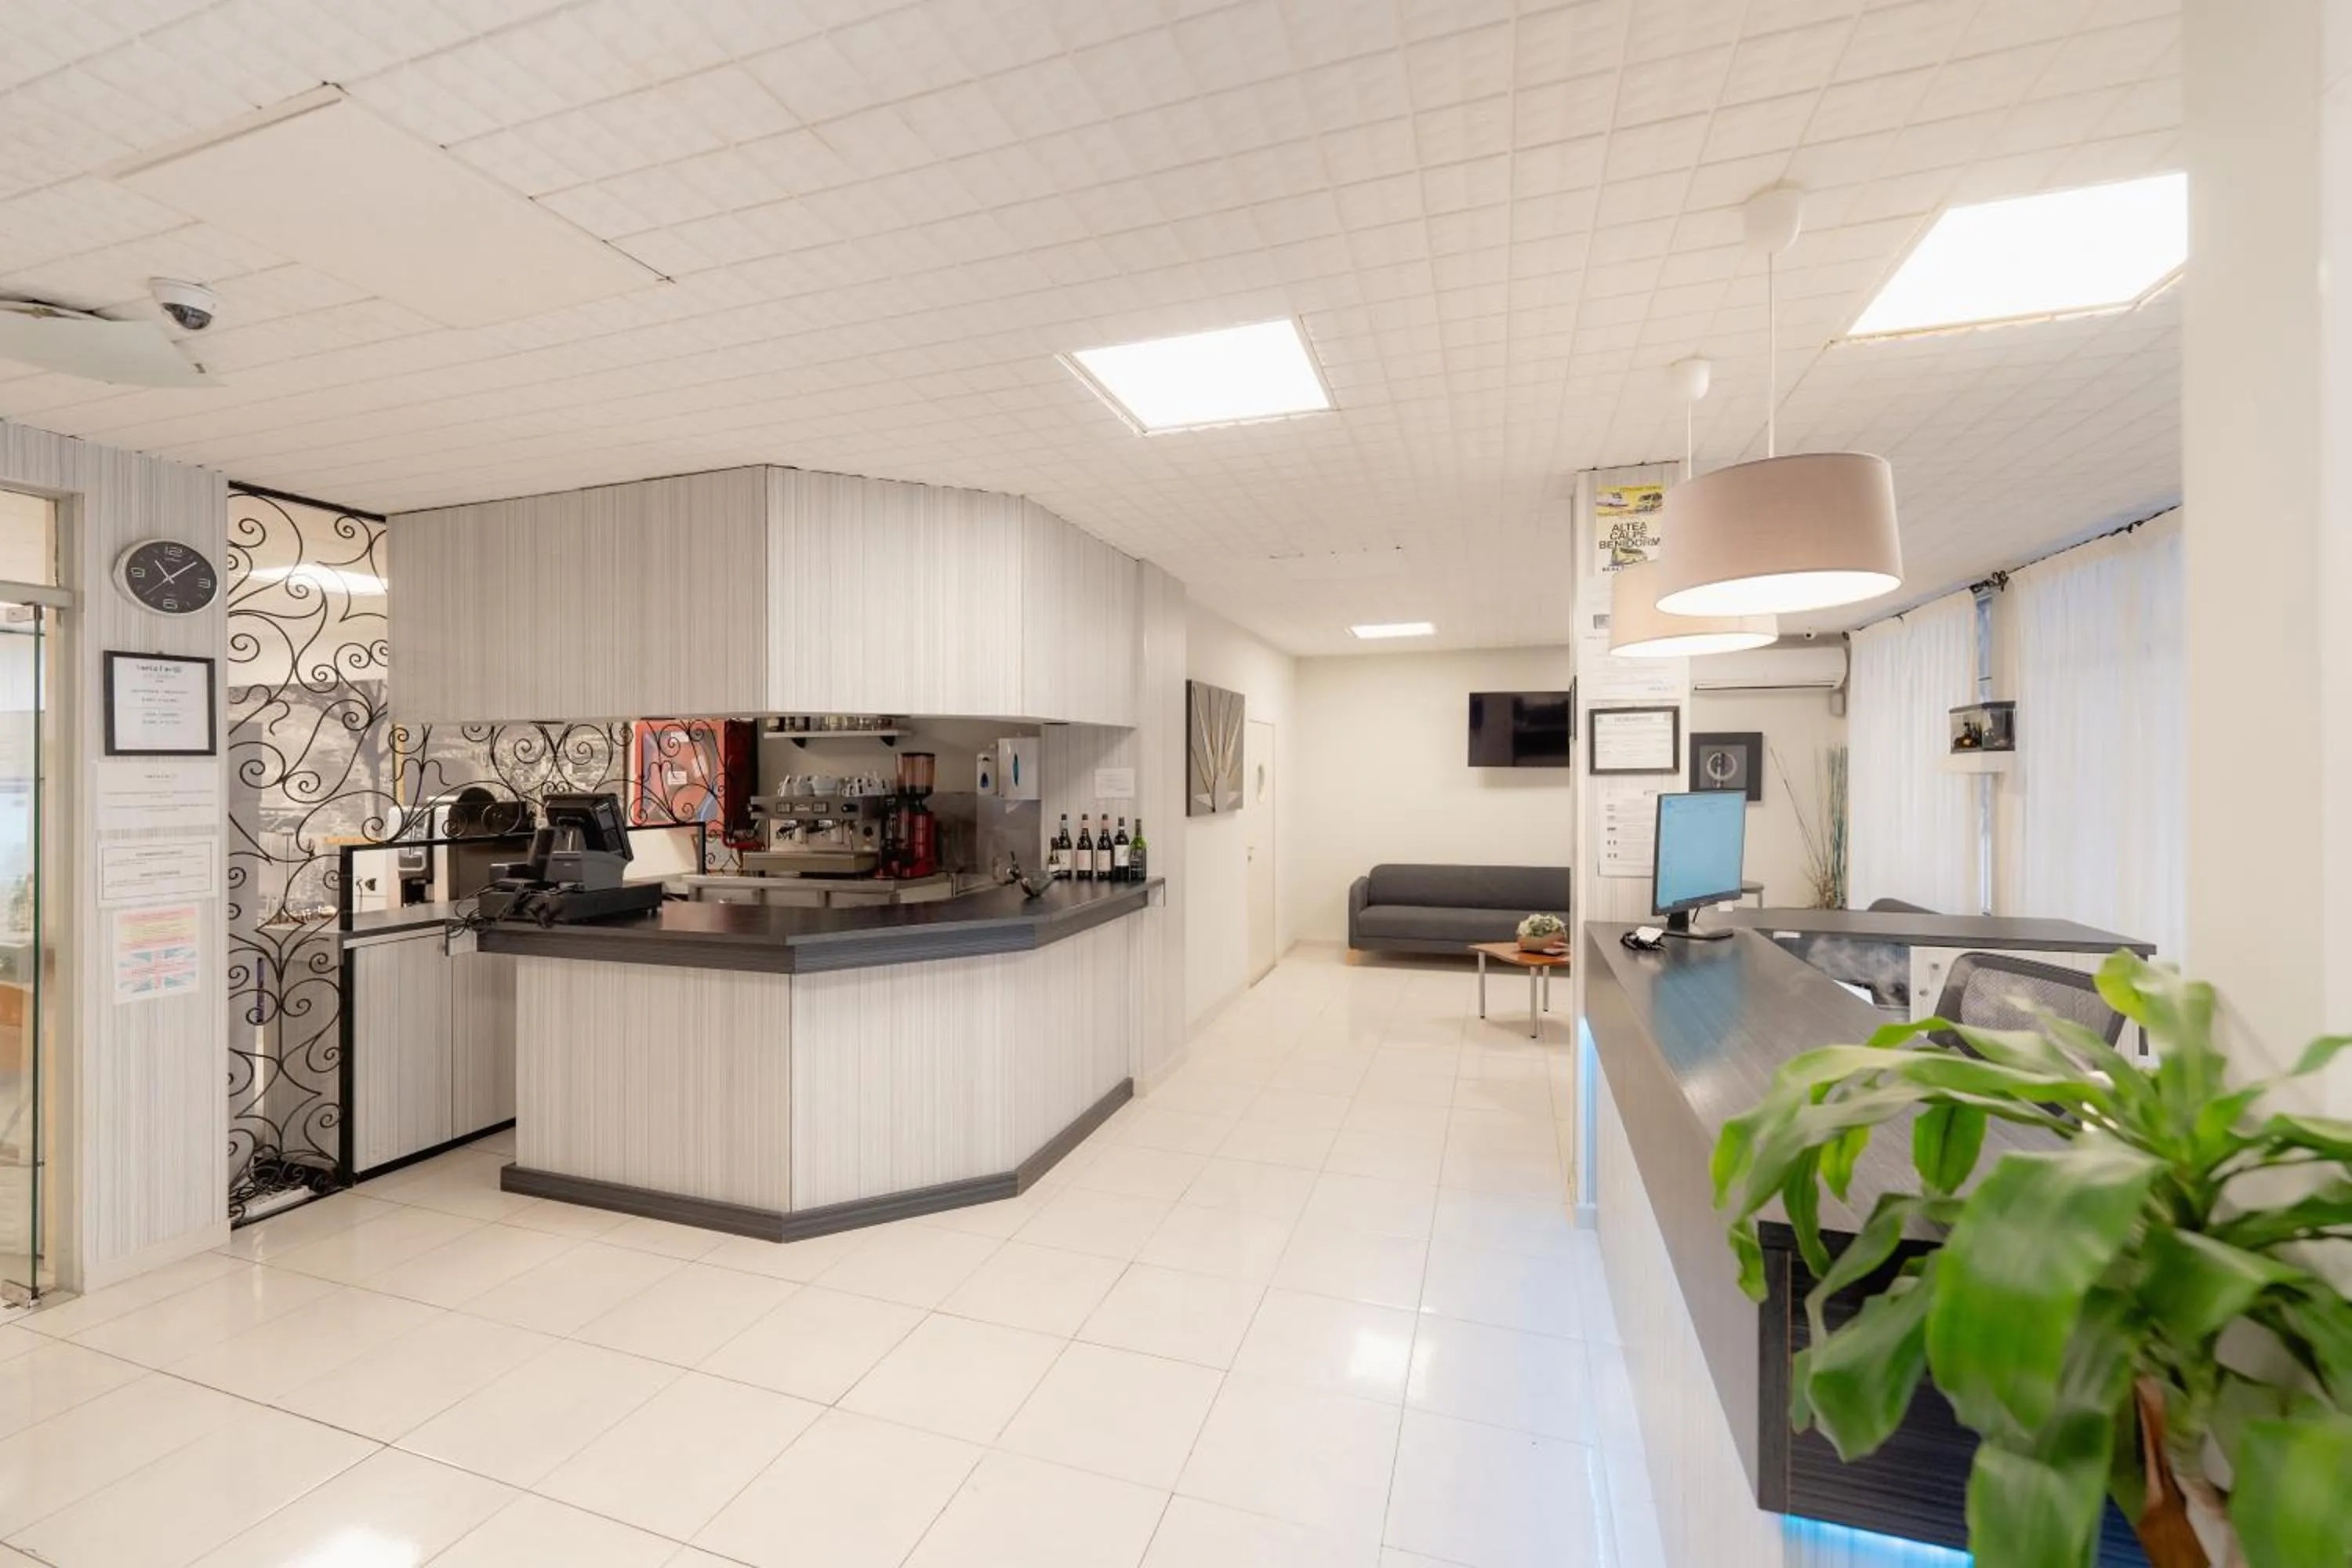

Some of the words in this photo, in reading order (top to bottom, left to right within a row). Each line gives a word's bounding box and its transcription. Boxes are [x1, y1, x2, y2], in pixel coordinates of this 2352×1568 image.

[1611, 521, 1647, 532] ALTEA
[1610, 530, 1647, 540] CALPE
[1599, 537, 1661, 550] BENIDORM
[165, 546, 183, 557] 12
[131, 567, 146, 578] 9
[198, 578, 211, 589] 3
[162, 598, 178, 610] 6
